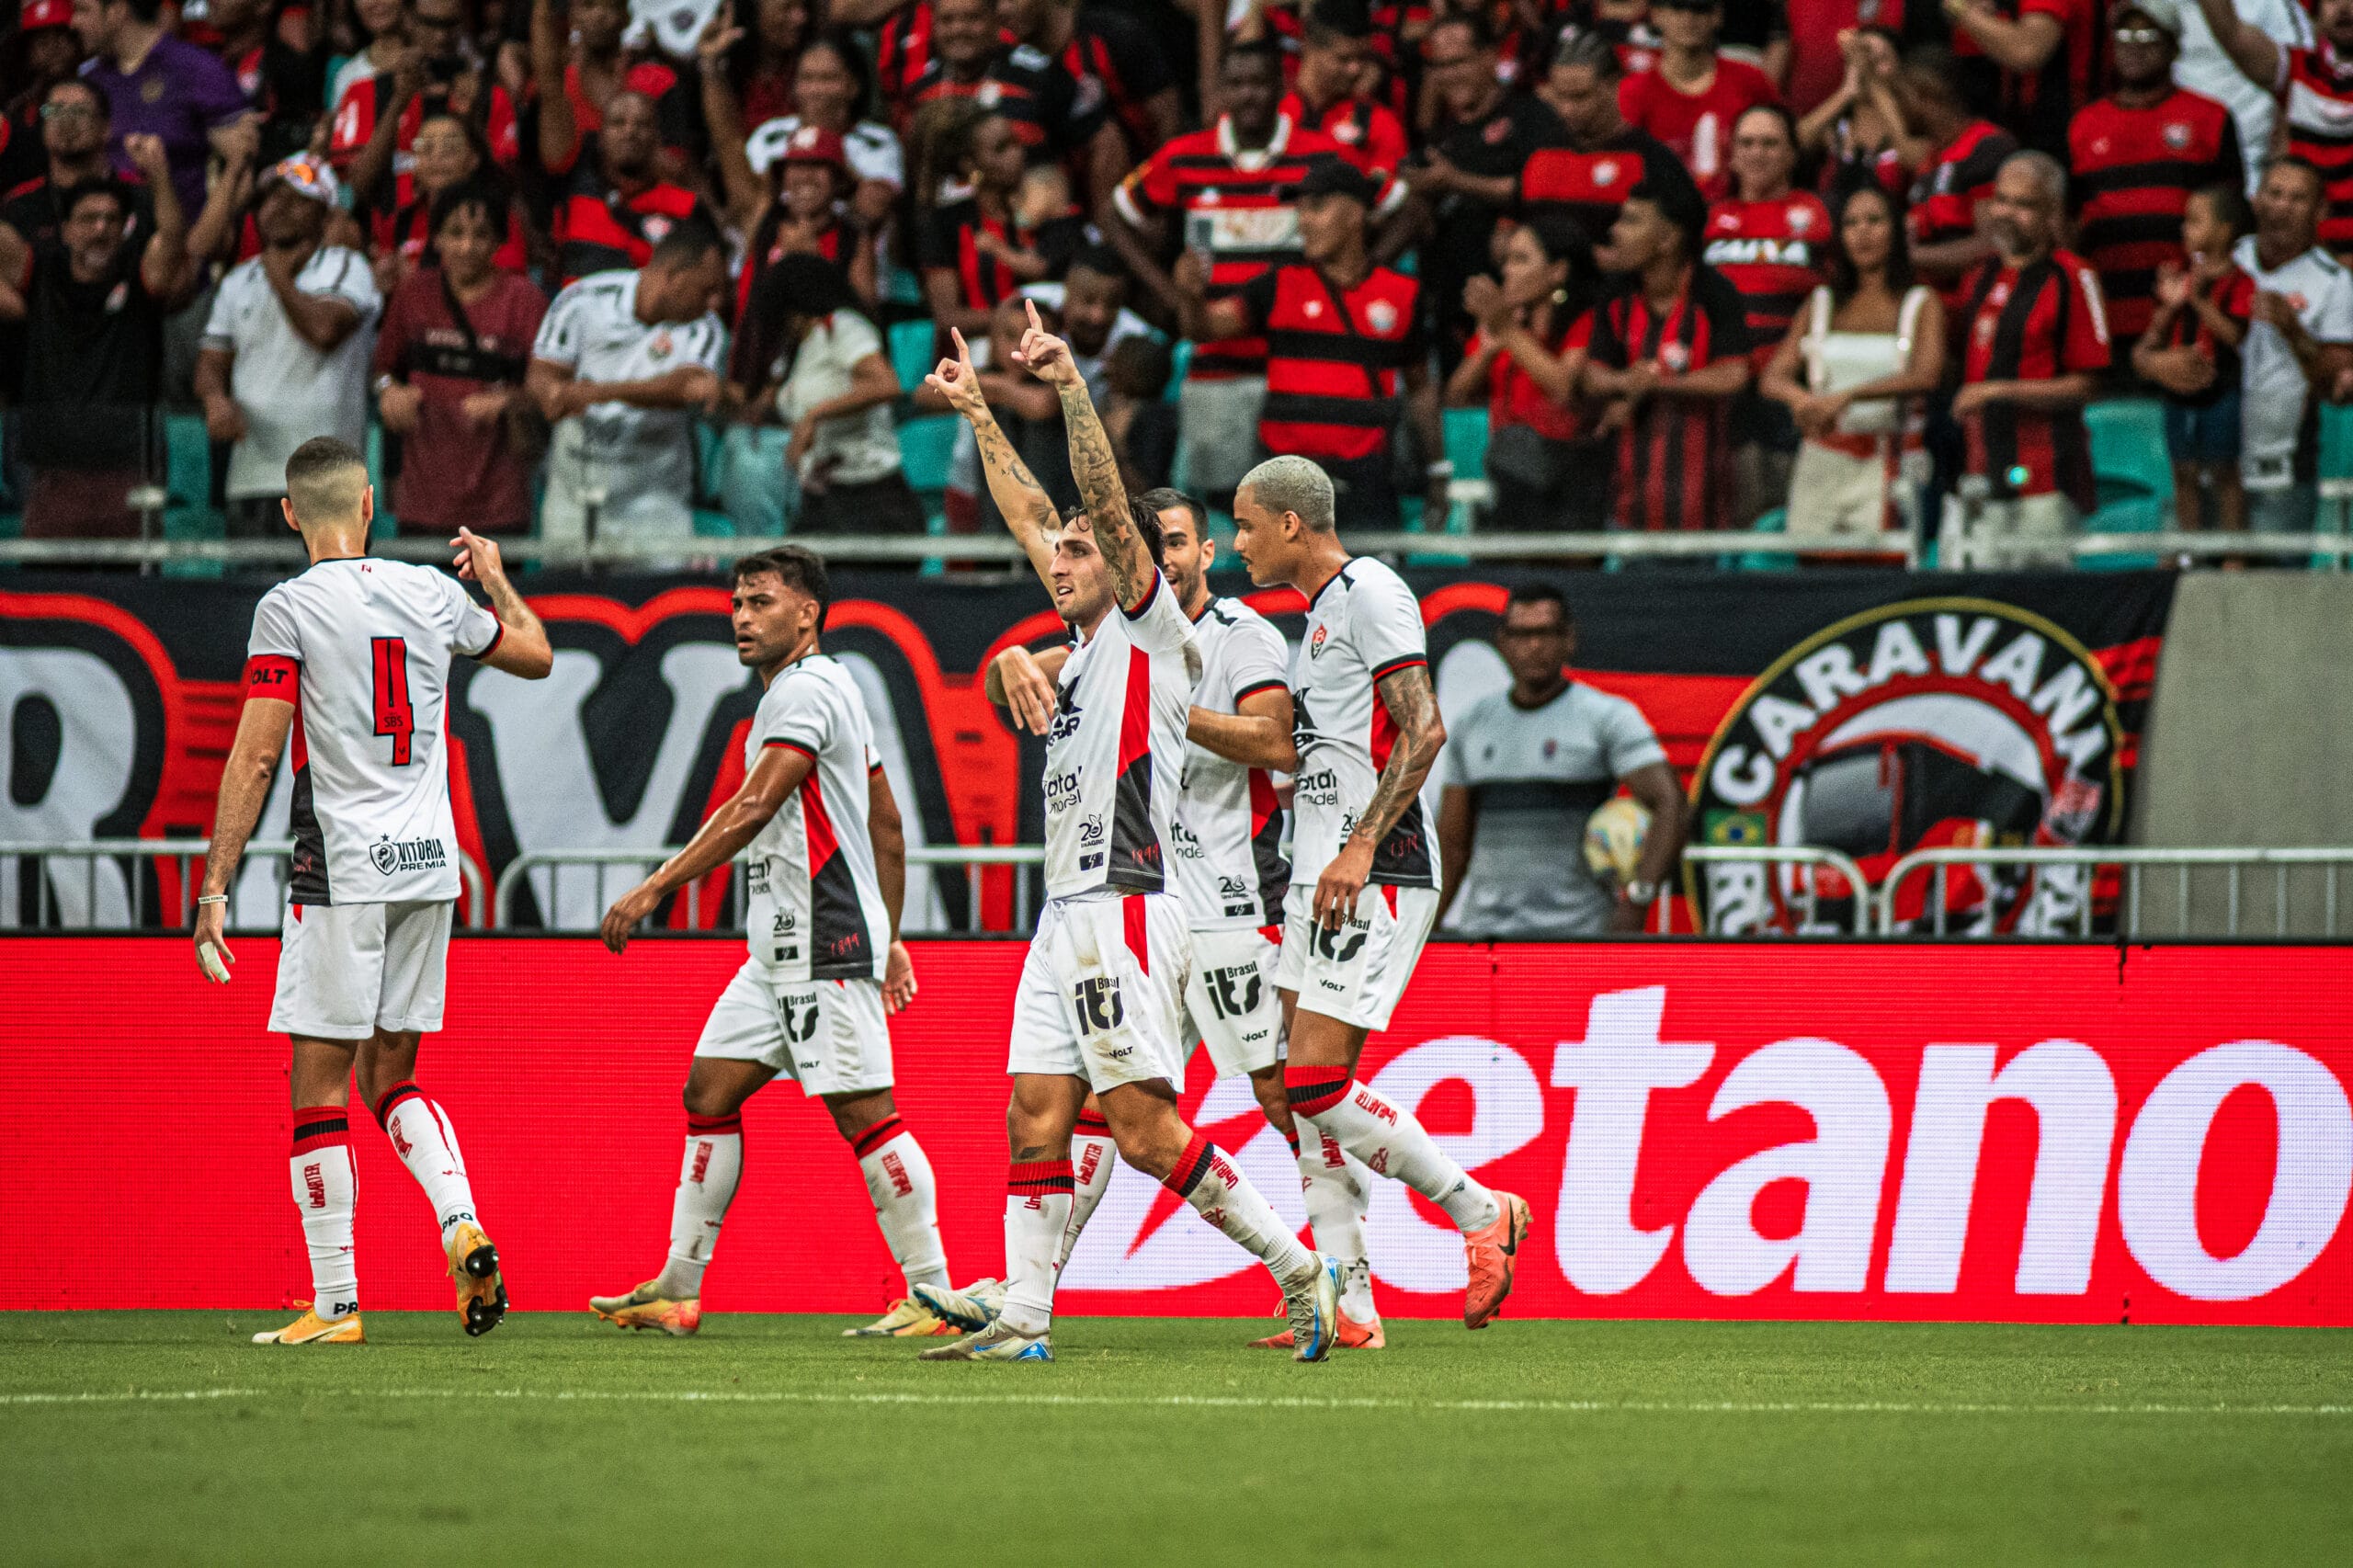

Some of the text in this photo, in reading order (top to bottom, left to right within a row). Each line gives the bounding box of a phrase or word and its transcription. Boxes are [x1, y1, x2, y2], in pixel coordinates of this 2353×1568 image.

[250, 667, 289, 686] OLT
[369, 636, 415, 767] 4
[383, 715, 404, 728] SBS
[397, 835, 446, 863] VITÓRIA
[400, 859, 447, 871] PREMIA
[831, 932, 860, 956] 1899
[1226, 960, 1258, 979] Brasil
[1203, 968, 1262, 1020] its
[1319, 979, 1346, 992] VOLT
[790, 992, 817, 1007] Brasil
[1242, 1028, 1268, 1042] VOLT
[1109, 1046, 1133, 1059] VOLT
[442, 1212, 473, 1233] PRO
